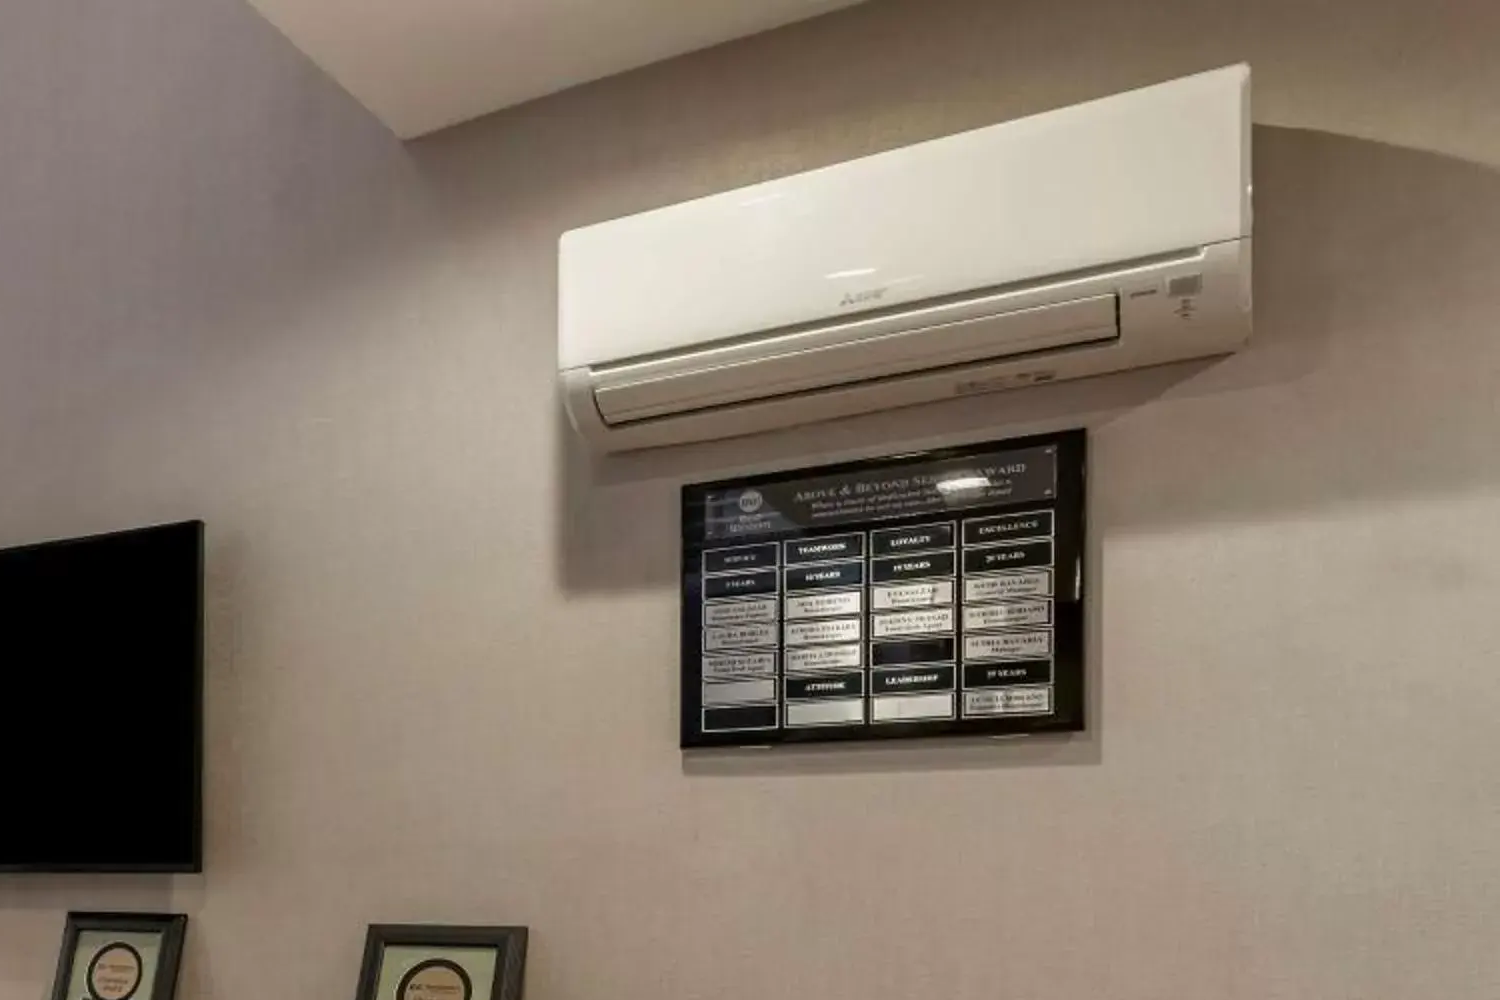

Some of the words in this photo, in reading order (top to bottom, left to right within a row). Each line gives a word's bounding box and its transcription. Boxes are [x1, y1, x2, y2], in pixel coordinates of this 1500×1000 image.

[794, 487, 836, 502] ABOVE
[855, 478, 910, 494] BEYOND
[889, 534, 932, 547] LOYALTY
[798, 541, 847, 555] TEAMWORK
